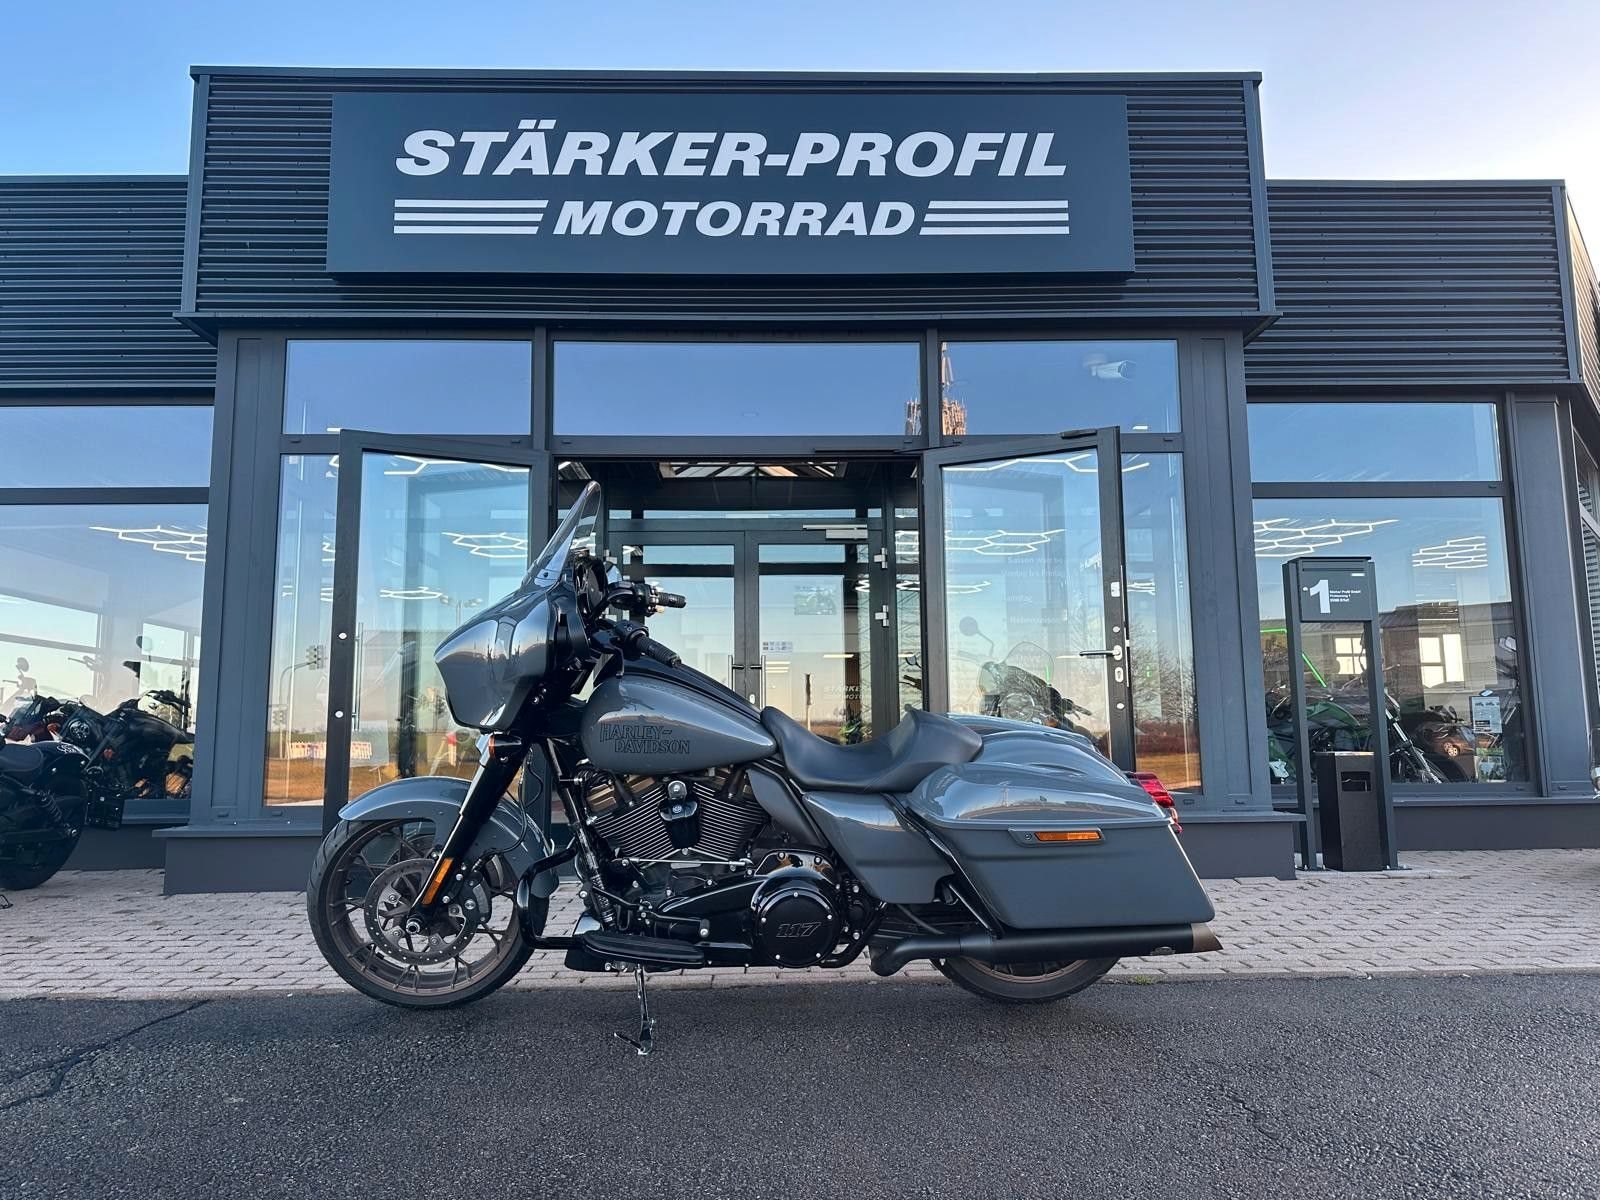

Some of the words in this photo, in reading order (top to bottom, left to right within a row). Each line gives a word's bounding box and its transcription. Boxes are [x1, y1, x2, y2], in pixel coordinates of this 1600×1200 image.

[395, 119, 1067, 177] STÄRKER-PROFIL
[552, 200, 915, 237] MOTORRAD
[1309, 579, 1331, 614] 1
[615, 740, 690, 754] DAVIDSON
[776, 921, 821, 938] 117
